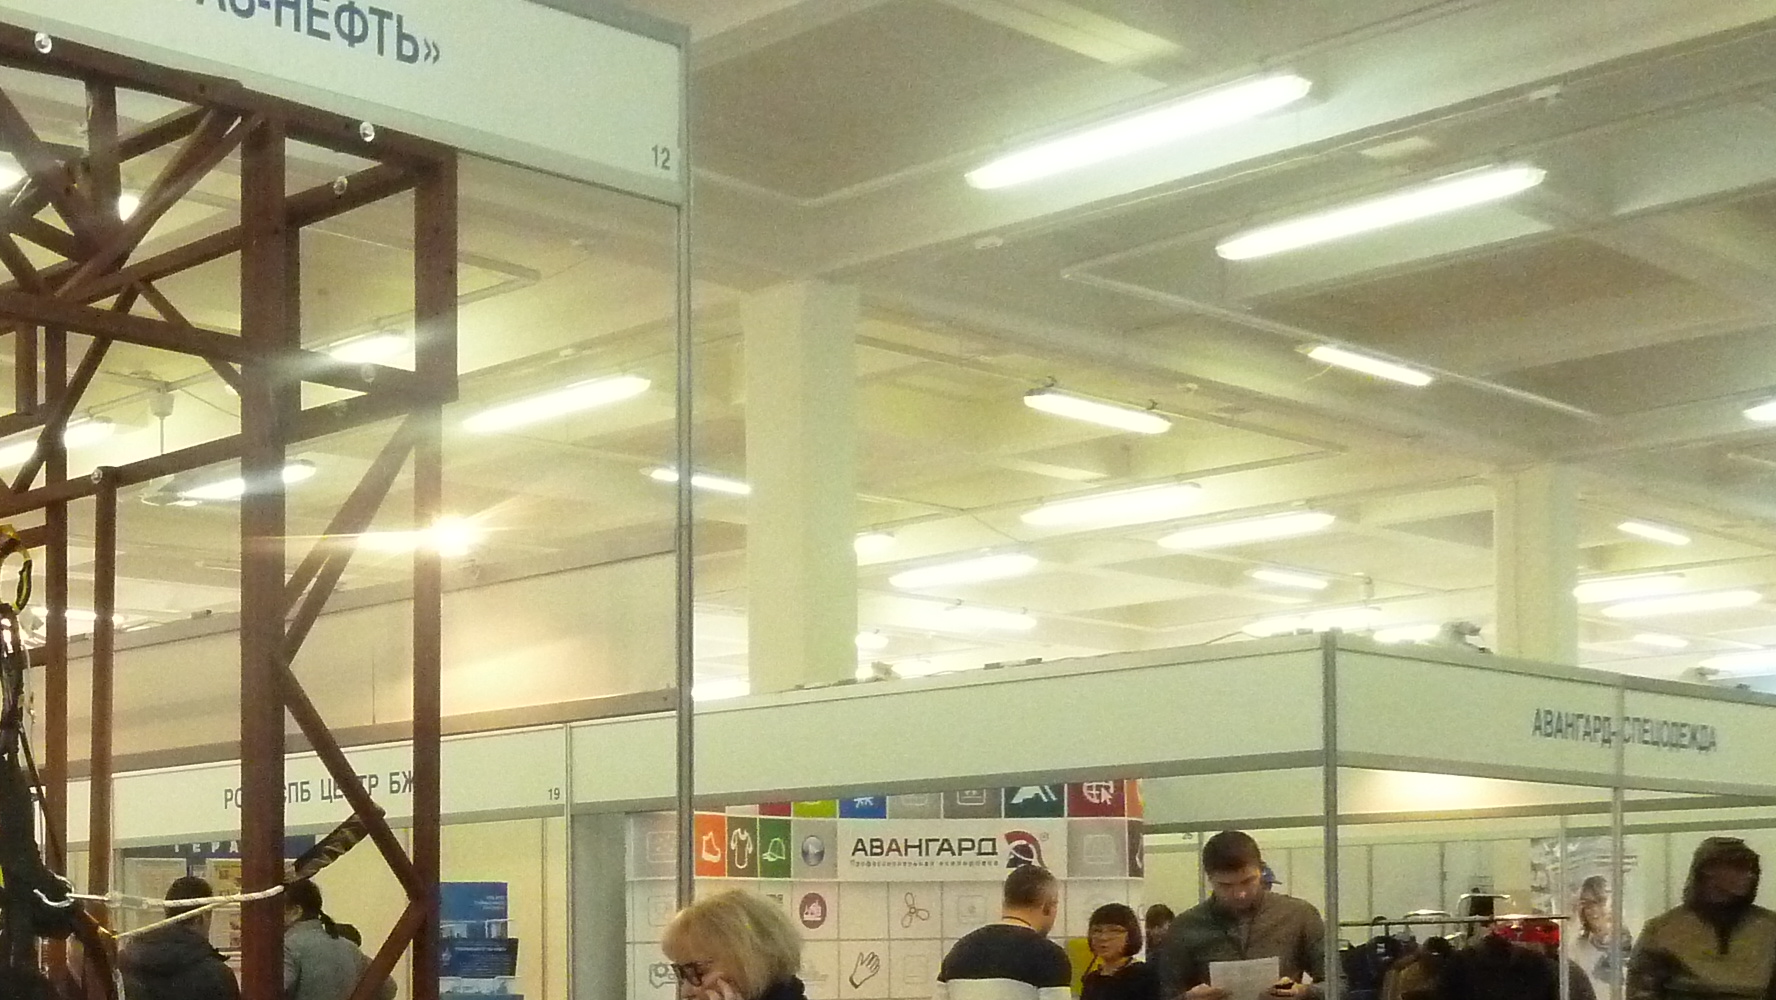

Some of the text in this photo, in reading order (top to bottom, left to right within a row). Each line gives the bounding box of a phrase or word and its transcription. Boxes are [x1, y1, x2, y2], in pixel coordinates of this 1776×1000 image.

[651, 144, 671, 171] 12
[320, 774, 379, 803] ЦЕТР
[547, 788, 561, 800] 19
[851, 837, 998, 857] АВАНГАРД
